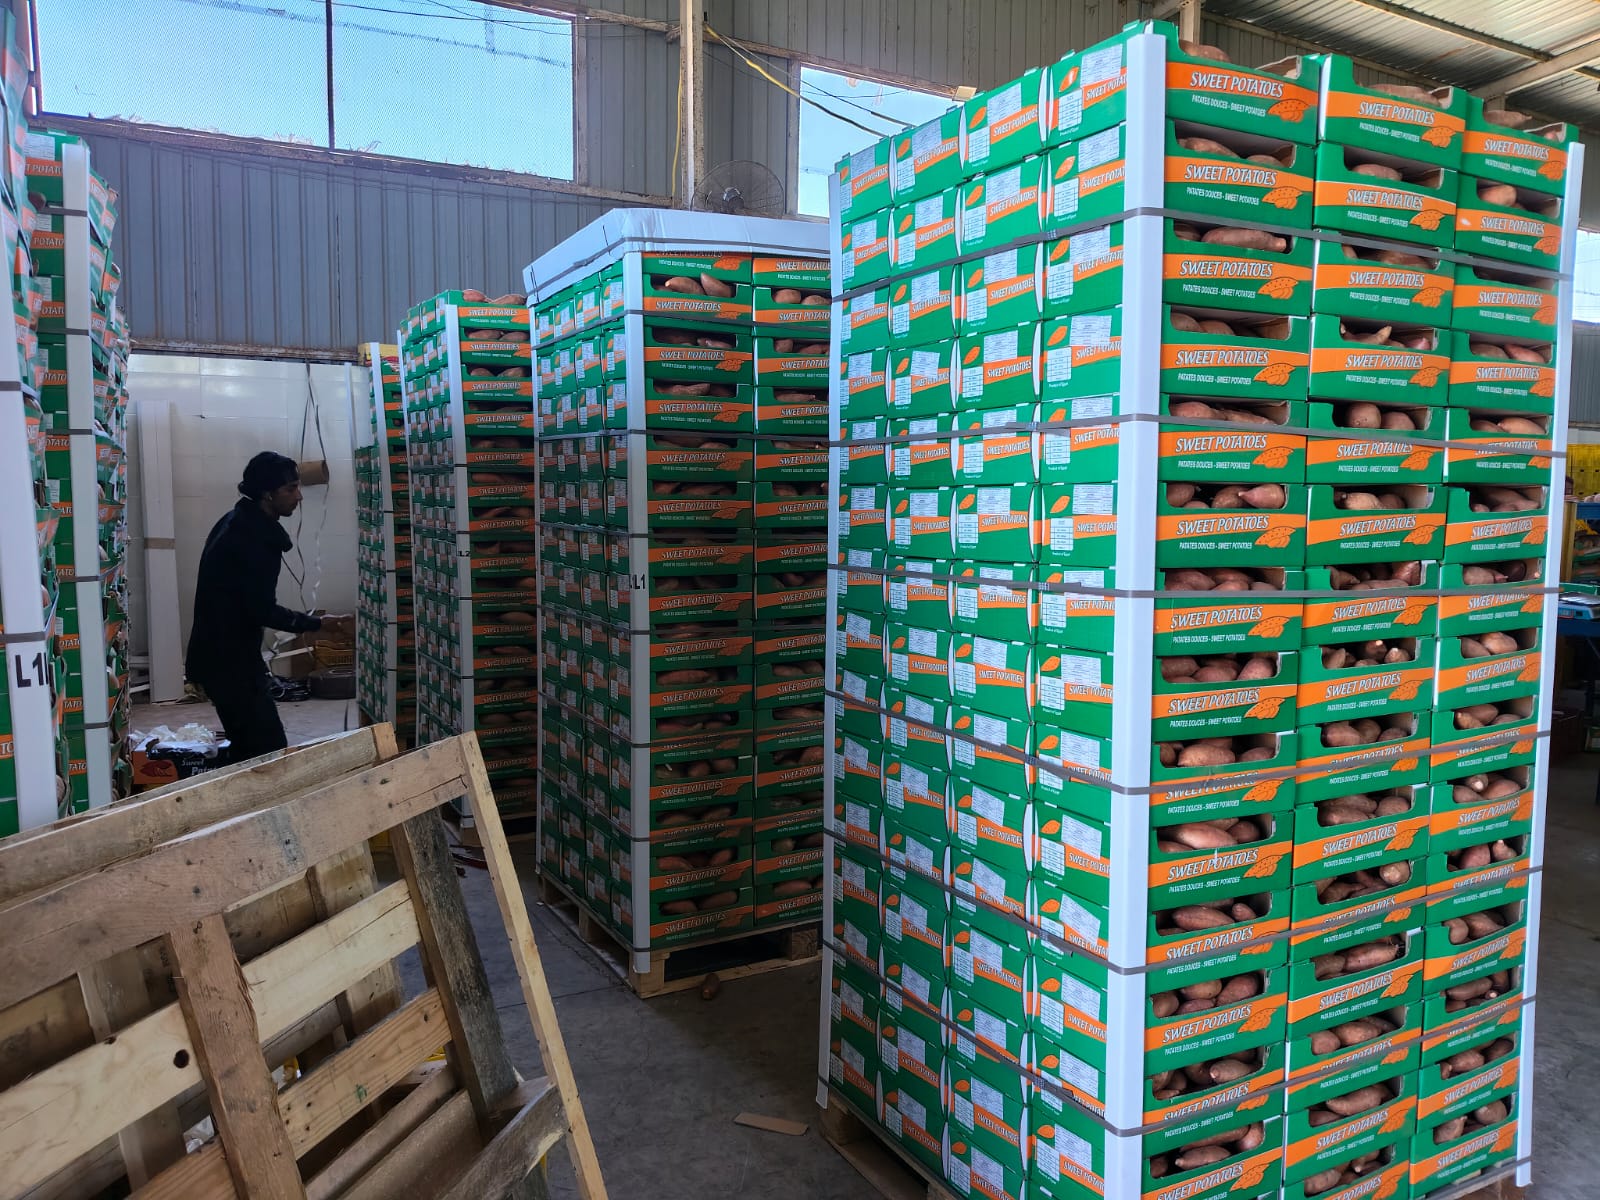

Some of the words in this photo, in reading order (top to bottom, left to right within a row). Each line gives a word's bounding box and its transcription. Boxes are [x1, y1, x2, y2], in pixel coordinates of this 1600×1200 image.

[1190, 72, 1230, 89] SWEET
[1230, 76, 1284, 97] POTATOES
[1231, 102, 1245, 112] SWEET
[1359, 102, 1392, 117] SWEET
[1392, 105, 1435, 124] POTATOES
[1484, 139, 1514, 154] SWEET
[1513, 143, 1550, 160] POTATOES
[1185, 165, 1225, 180] SWEET
[1225, 168, 1278, 185] POTATOES
[1225, 193, 1239, 202] SWEET
[1346, 189, 1380, 204] SWEET
[1380, 192, 1423, 210] POTATOES
[1481, 216, 1510, 230] SWEET
[1510, 220, 1544, 234] POTATOES
[1180, 260, 1221, 276] SWEET
[1221, 261, 1273, 277] POTATOES
[1348, 272, 1382, 285] SWEET
[1382, 272, 1424, 286] POTATOES
[991, 288, 1008, 299] SWEET
[1007, 278, 1034, 296] POTATOES
[1221, 288, 1235, 297] SWEET
[656, 302, 682, 310] SWEET
[683, 302, 722, 311] POTATOES
[1478, 292, 1506, 304] SWEET
[1506, 293, 1542, 306] POTATOES
[779, 312, 801, 320] SWEET
[660, 351, 684, 359] SWEET
[687, 351, 725, 360] POTATOES
[1176, 350, 1218, 365] SWEET
[1218, 350, 1270, 365] POTATOES
[1346, 355, 1381, 368] SWEET
[1380, 354, 1423, 368] POTATOES
[988, 368, 1004, 378] SWEET
[1004, 360, 1032, 374] POTATOES
[1476, 367, 1504, 380] SWEET
[1504, 367, 1540, 380] POTATOES
[658, 404, 684, 412] SWEET
[684, 403, 722, 411] POTATOES
[987, 446, 1002, 454] SWEET
[1002, 440, 1030, 452] POTATOES
[1074, 432, 1096, 444] SWEET
[1176, 437, 1216, 452] SWEET
[1215, 434, 1268, 450] POTATOES
[661, 454, 688, 462] SWEET
[688, 452, 726, 461] POTATOES
[1337, 442, 1370, 458] SWEET
[1370, 441, 1413, 455] POTATOES
[658, 504, 684, 512] SWEET
[684, 502, 722, 510] POTATOES
[1176, 518, 1217, 535] SWEET
[1217, 515, 1270, 532] POTATOES
[1340, 521, 1374, 536] SWEET
[1374, 516, 1416, 532] POTATOES
[1471, 524, 1500, 538] SWEET
[1500, 519, 1533, 534] POTATOES
[1218, 542, 1232, 550] SWEET
[1070, 600, 1090, 610] SWEET
[1332, 604, 1366, 620] SWEET
[1365, 597, 1408, 614] POTATOES
[1468, 595, 1494, 610] SWEET
[1170, 612, 1211, 628] SWEET
[1210, 606, 1263, 624] POTATOES
[1211, 634, 1225, 642] SWEET
[1466, 666, 1492, 682] SWEET
[1492, 656, 1526, 674] POTATOES
[1326, 681, 1360, 698] SWEET
[1360, 672, 1402, 690] POTATOES
[1168, 696, 1208, 714] SWEET
[1208, 688, 1260, 707] POTATOES
[1208, 718, 1222, 726] SWEET
[1458, 809, 1488, 824] SWEET
[1487, 798, 1520, 816] POTATOES
[980, 824, 998, 836] SWEET
[998, 830, 1022, 845] POTATOES
[1322, 836, 1356, 856] SWEET
[1355, 824, 1398, 846] POTATOES
[1168, 860, 1206, 880] SWEET
[1207, 849, 1258, 871] POTATOES
[1206, 879, 1220, 888] SWEET
[1166, 940, 1203, 960] SWEET
[1203, 926, 1254, 952] POTATOES
[1452, 952, 1476, 970] SWEET
[1476, 938, 1510, 959] POTATOES
[1320, 990, 1352, 1010] SWEET
[1352, 971, 1394, 998] POTATOES
[1068, 1013, 1088, 1030] SWEET
[1162, 1021, 1202, 1042] SWEET
[1202, 1004, 1252, 1030] POTATOES
[1202, 1038, 1215, 1046] SWEET
[1444, 1084, 1470, 1104] SWEET
[1470, 1067, 1504, 1092] POTATOES
[1201, 1082, 1250, 1110] POTATOES
[1316, 1129, 1348, 1150] SWEET
[1348, 1108, 1390, 1135] POTATOES
[1437, 1148, 1464, 1169] SWEET
[1463, 1131, 1500, 1155] POTATOES
[1158, 1182, 1194, 1200] SWEET
[1194, 1160, 1244, 1193] POTATOES
[1343, 1174, 1382, 1200] POTATOES
